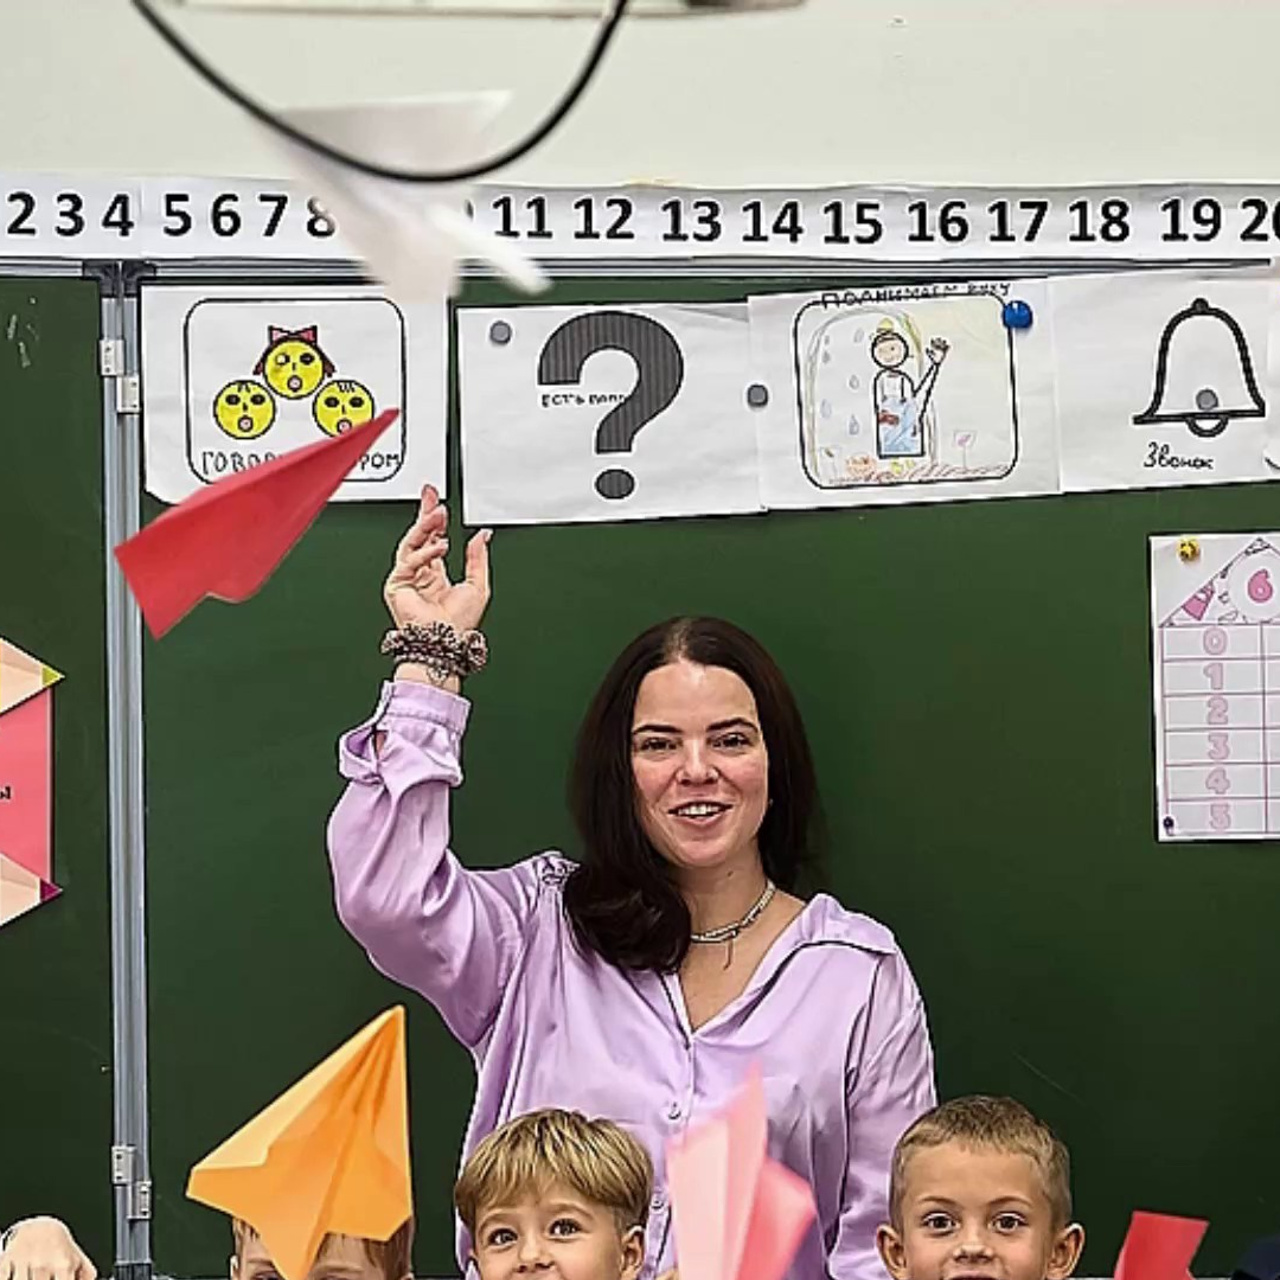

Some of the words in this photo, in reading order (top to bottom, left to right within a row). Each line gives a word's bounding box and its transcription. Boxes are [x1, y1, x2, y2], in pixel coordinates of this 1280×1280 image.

[7, 191, 36, 235] 2
[55, 193, 85, 237] 3
[101, 194, 135, 237] 4
[163, 193, 192, 237] 5
[211, 193, 241, 237] 6
[259, 193, 288, 237] 7
[306, 197, 336, 238] 8
[492, 196, 553, 239] 11
[574, 198, 635, 240] 12
[661, 199, 722, 242] 13
[742, 200, 804, 243] 14
[823, 201, 883, 244] 15
[908, 201, 969, 242] 16
[988, 201, 1048, 242] 17
[1069, 199, 1130, 242] 18
[1161, 198, 1221, 242] 19
[1247, 569, 1273, 603] 6
[1203, 628, 1227, 655] 0
[1203, 662, 1223, 689] 1
[1208, 697, 1228, 725] 2
[1208, 733, 1230, 760] 3
[1205, 767, 1230, 795] 4
[1210, 803, 1231, 830] 5
